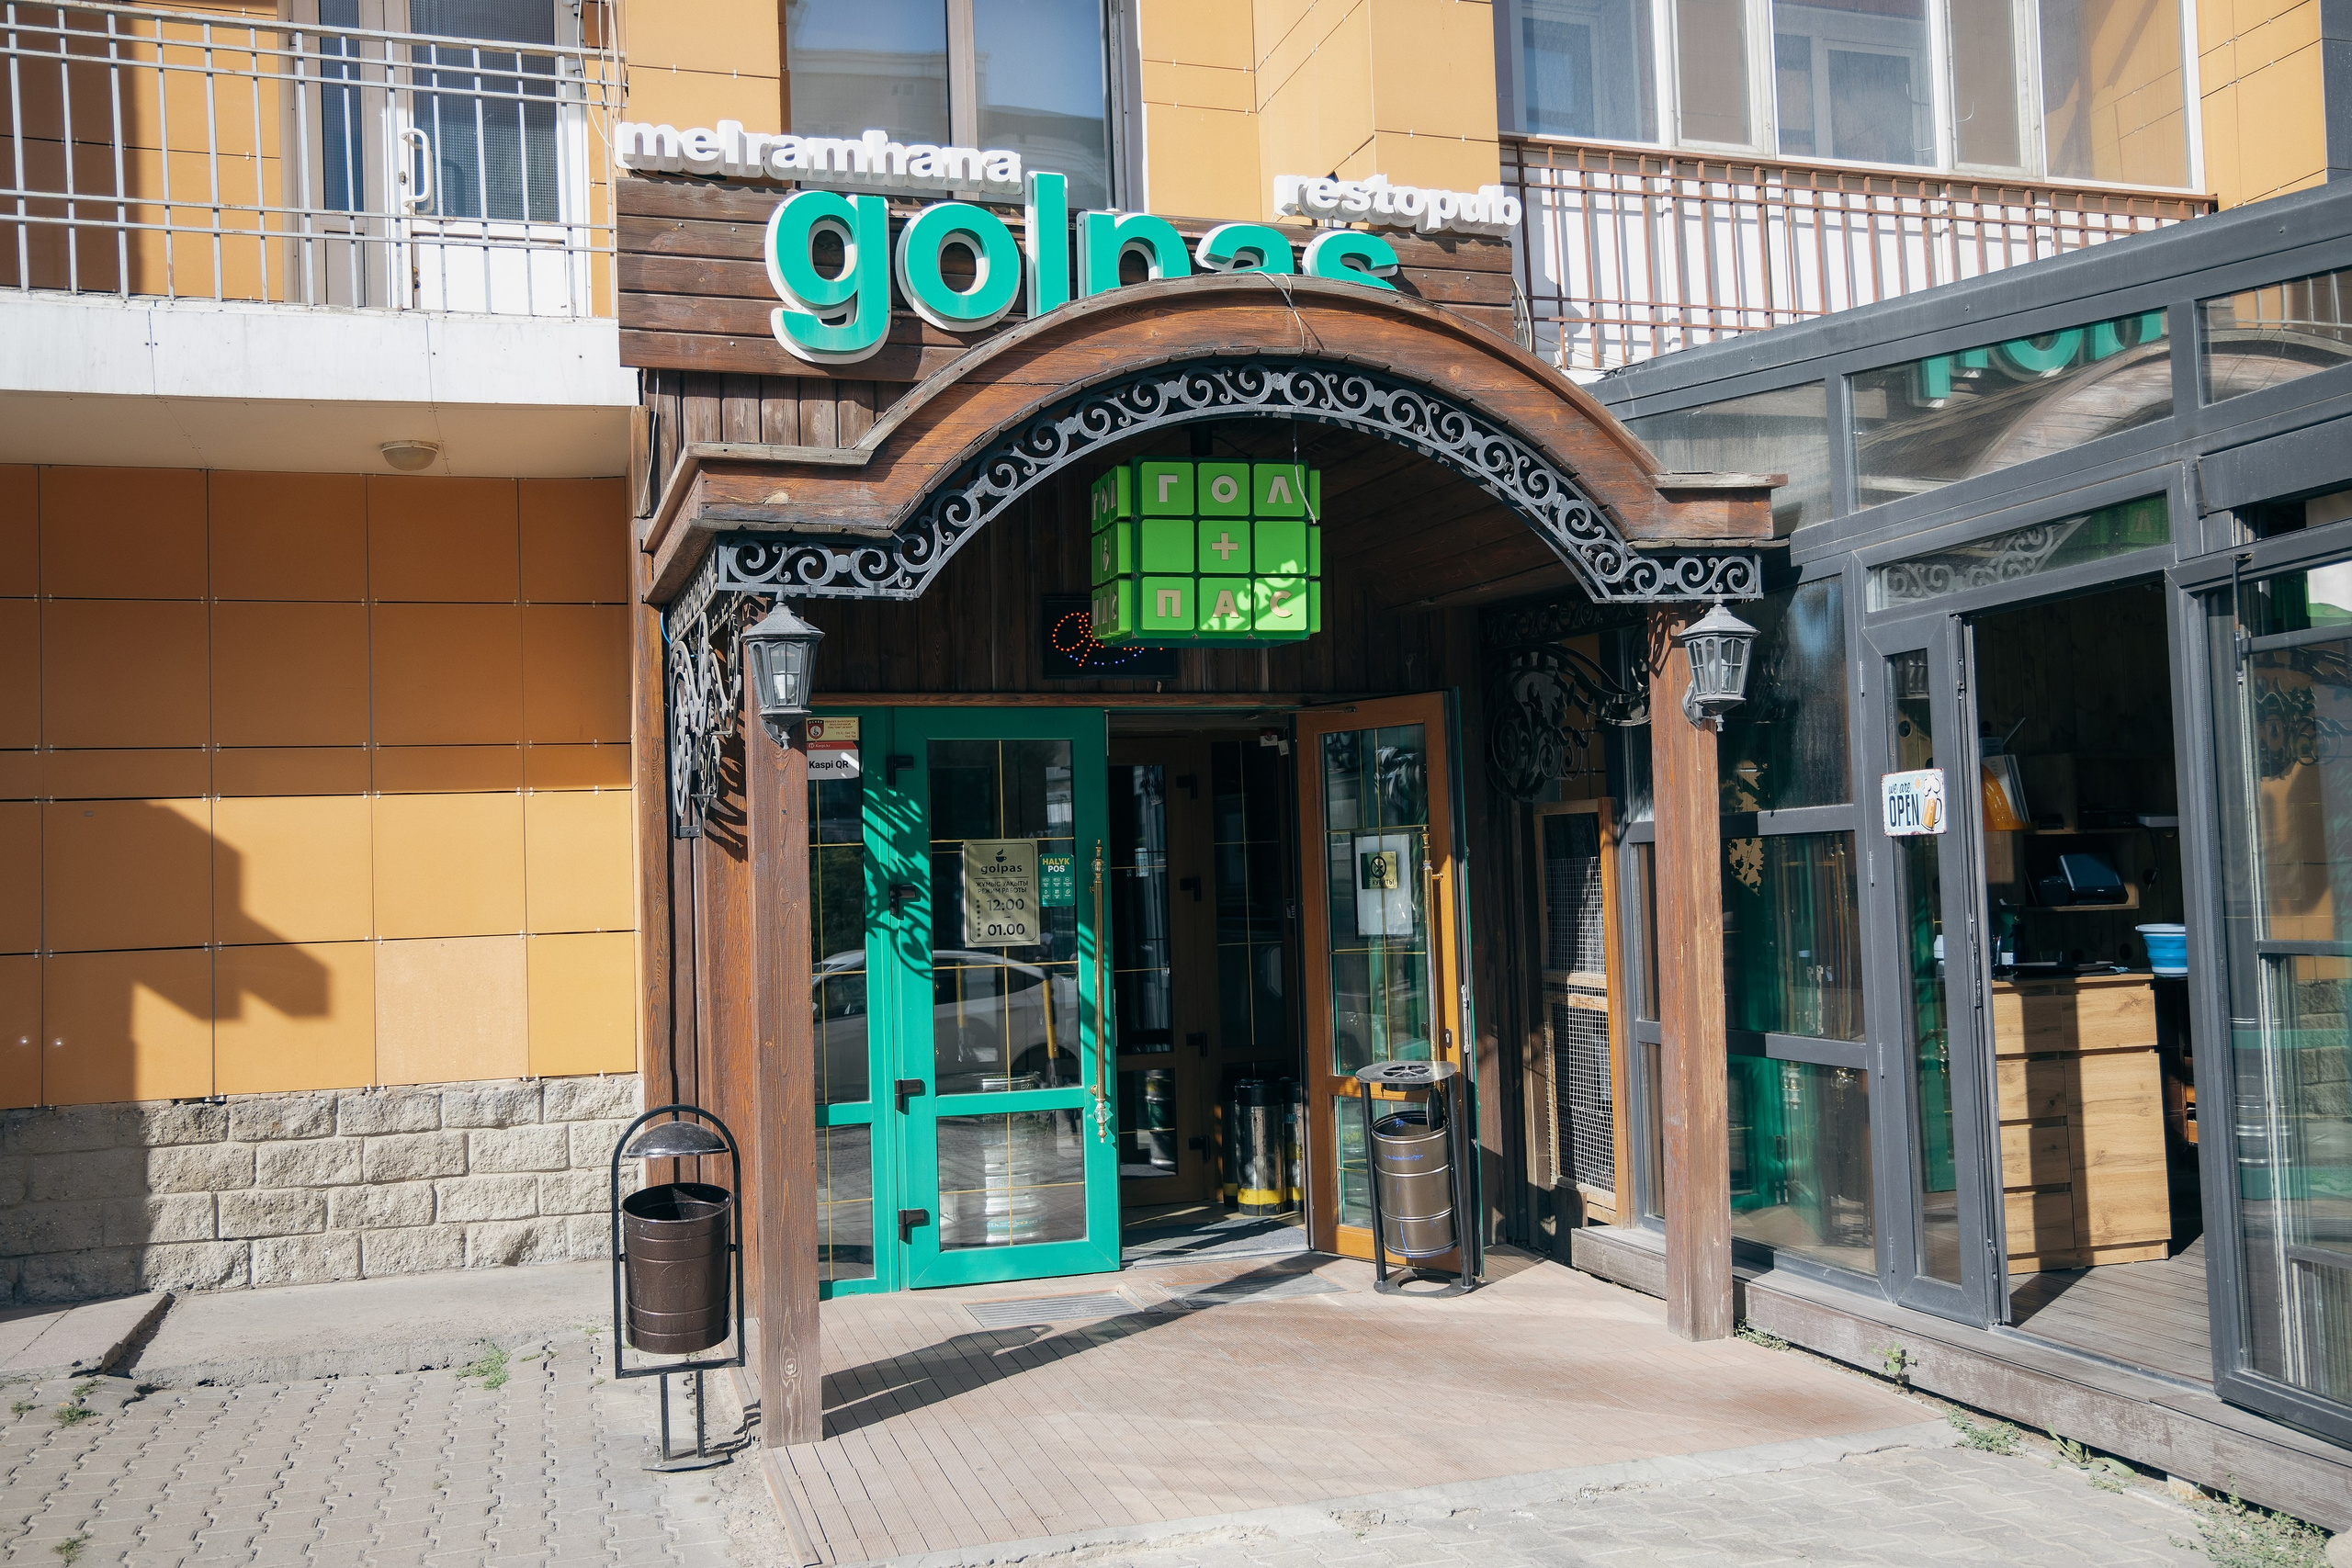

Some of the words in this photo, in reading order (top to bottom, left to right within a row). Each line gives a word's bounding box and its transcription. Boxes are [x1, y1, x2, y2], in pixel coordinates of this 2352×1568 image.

[1273, 174, 1521, 236] restopub
[1158, 474, 1293, 503] ГОЛ
[1157, 590, 1293, 618] ПАС
[808, 761, 833, 770] Kaspi
[835, 761, 849, 769] QR
[1888, 783, 1898, 795] we
[1899, 782, 1911, 794] are
[1889, 794, 1920, 827] OPEN
[980, 863, 1023, 874] golpas
[987, 898, 1024, 911] 12:00
[987, 923, 1025, 936] 01.00
